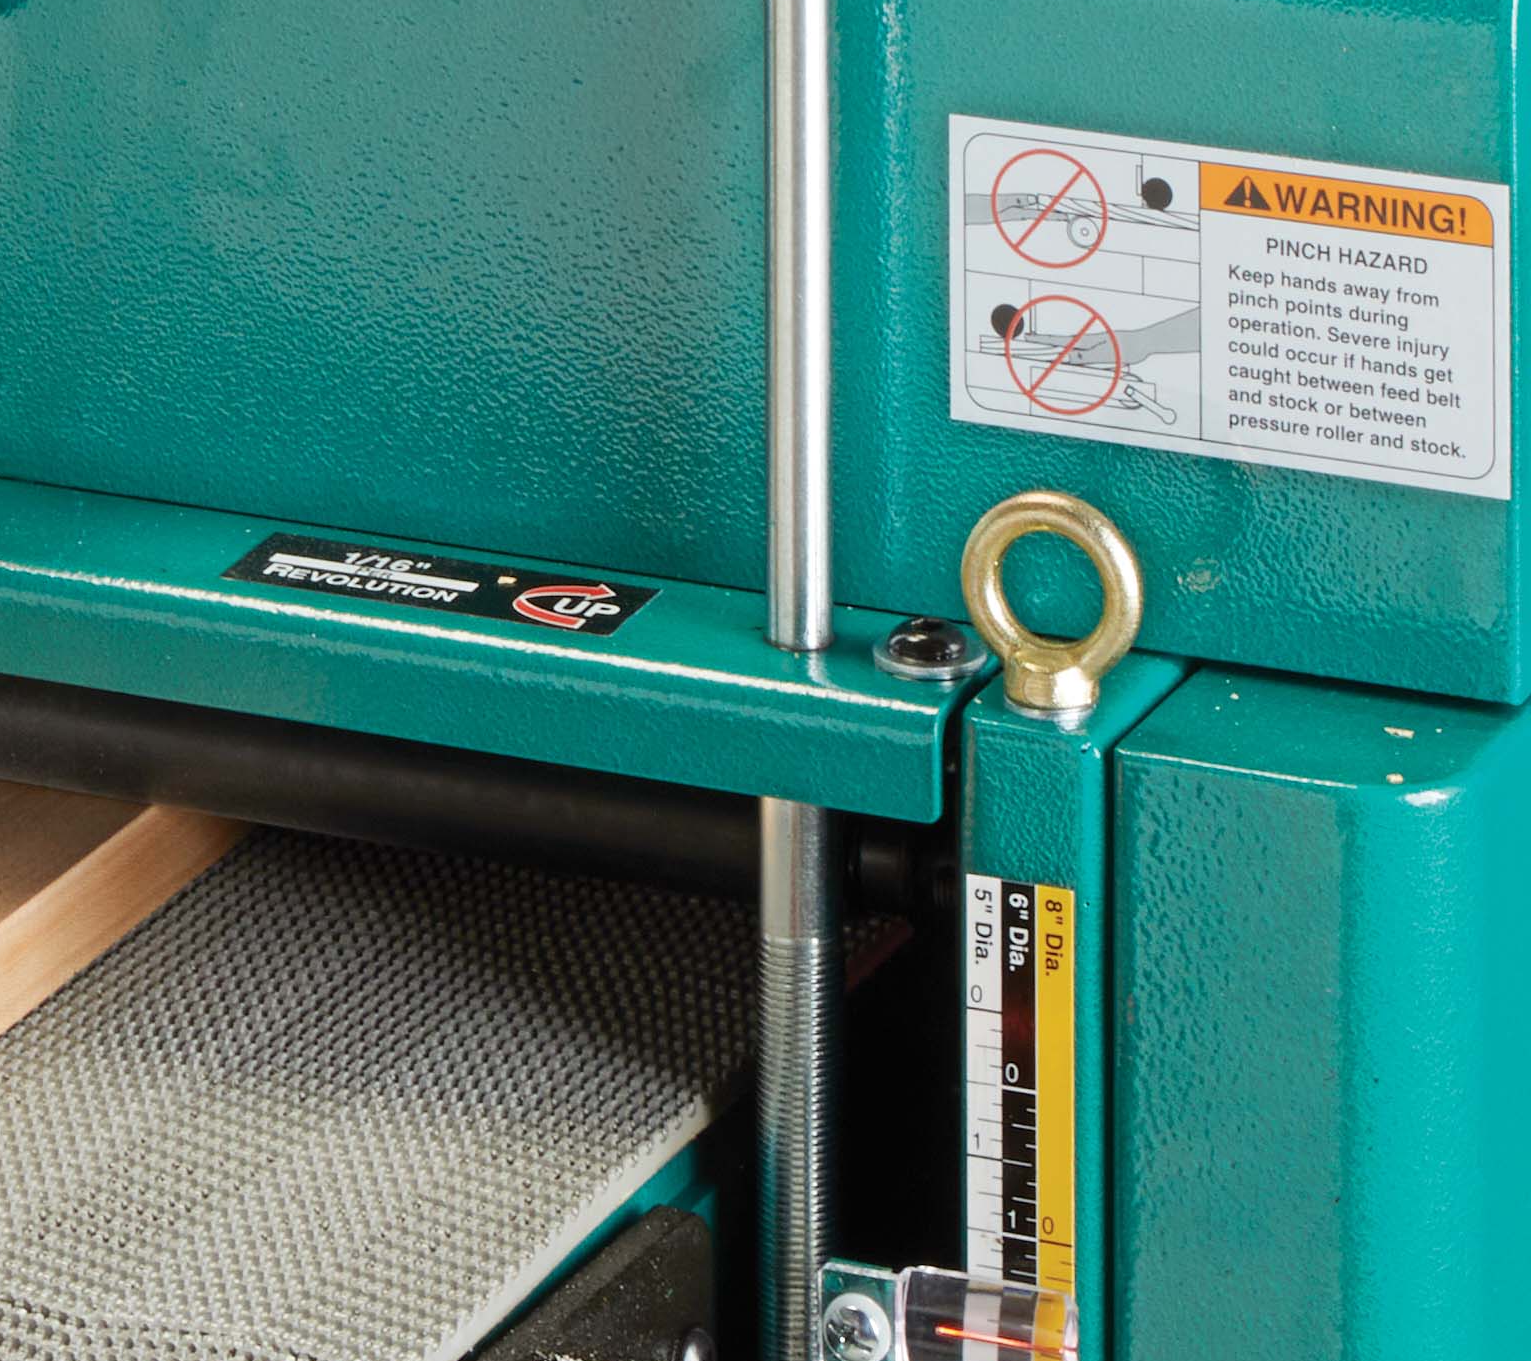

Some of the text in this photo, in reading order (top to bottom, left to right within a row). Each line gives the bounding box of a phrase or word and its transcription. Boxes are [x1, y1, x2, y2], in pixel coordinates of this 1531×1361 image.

[1274, 183, 1466, 236] WARNING!
[1266, 237, 1428, 275] PINCH HAZARD
[1228, 263, 1439, 308] Keep hands away from
[1228, 290, 1408, 332] pinch points during
[1228, 316, 1450, 362] operation. Severe injury
[1228, 340, 1453, 385] could occur if hands get
[1228, 364, 1461, 409] caught between feed belt
[1228, 389, 1427, 428] and stock or between
[1229, 413, 1466, 459] pressure roller and stock.
[345, 552, 432, 571] 1/16"
[263, 563, 459, 603] REVOLUTION
[553, 598, 621, 618] UP
[975, 888, 993, 964] 5" Dia.
[1009, 893, 1028, 972] 6" Dia.
[1045, 900, 1063, 976] 8" Dia.
[971, 985, 982, 1003] 0
[1005, 1063, 1019, 1083] 0
[973, 1133, 980, 1150] 1
[1007, 1209, 1017, 1229] 1
[1042, 1216, 1054, 1235] 0
